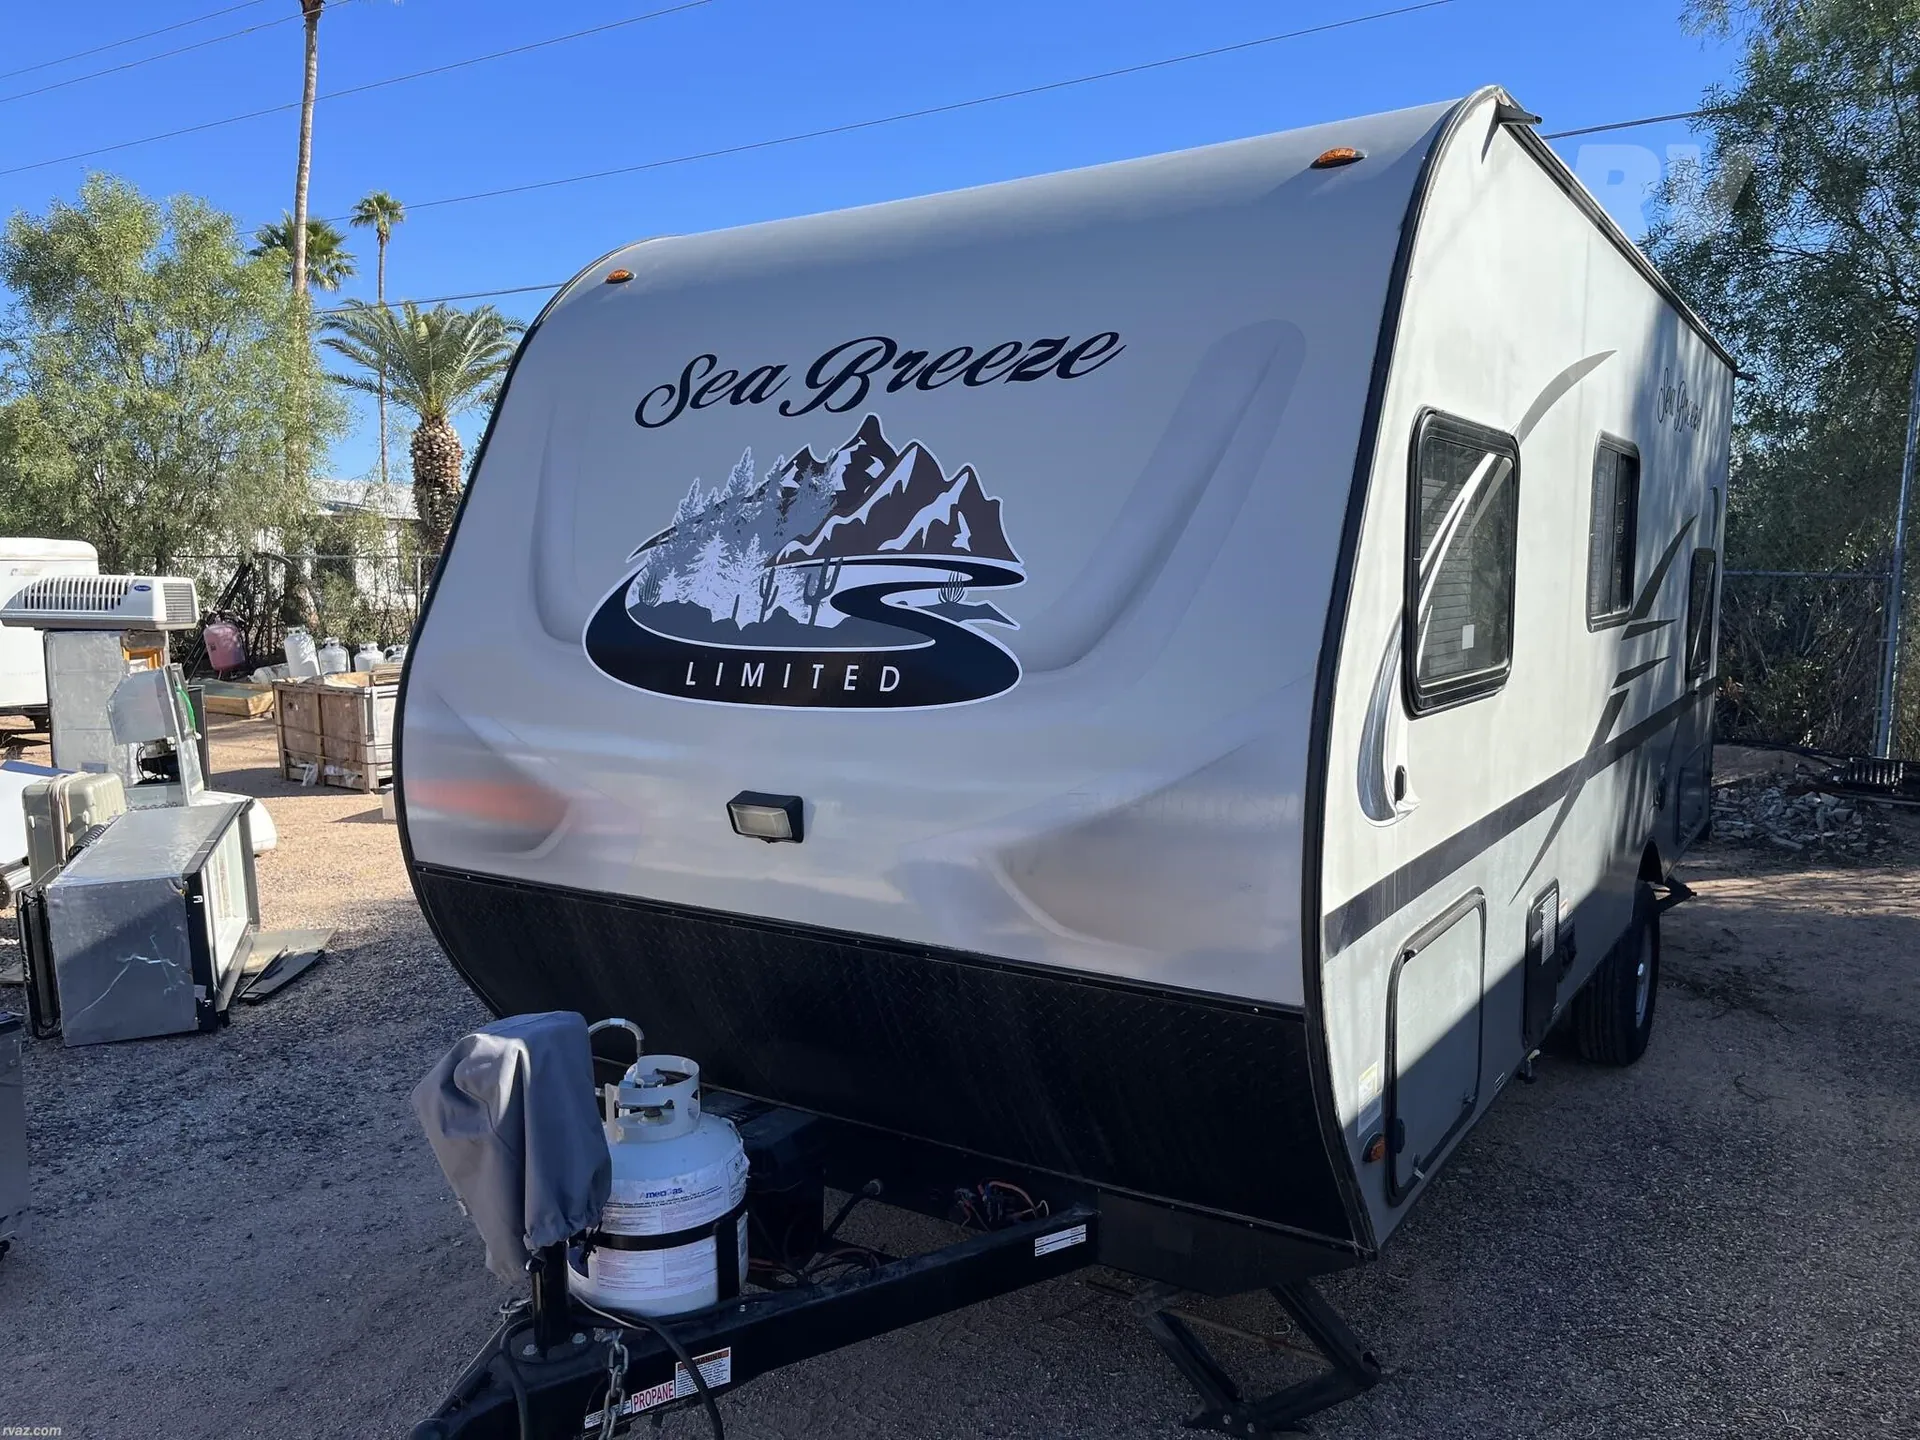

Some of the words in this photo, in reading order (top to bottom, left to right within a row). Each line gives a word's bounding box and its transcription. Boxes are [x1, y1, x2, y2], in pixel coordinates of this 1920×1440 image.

[635, 354, 789, 428] Sea
[779, 332, 1126, 416] Breeze
[1657, 367, 1676, 423] Sea
[686, 661, 901, 693] LIMITED
[633, 1383, 674, 1412] PROPANE
